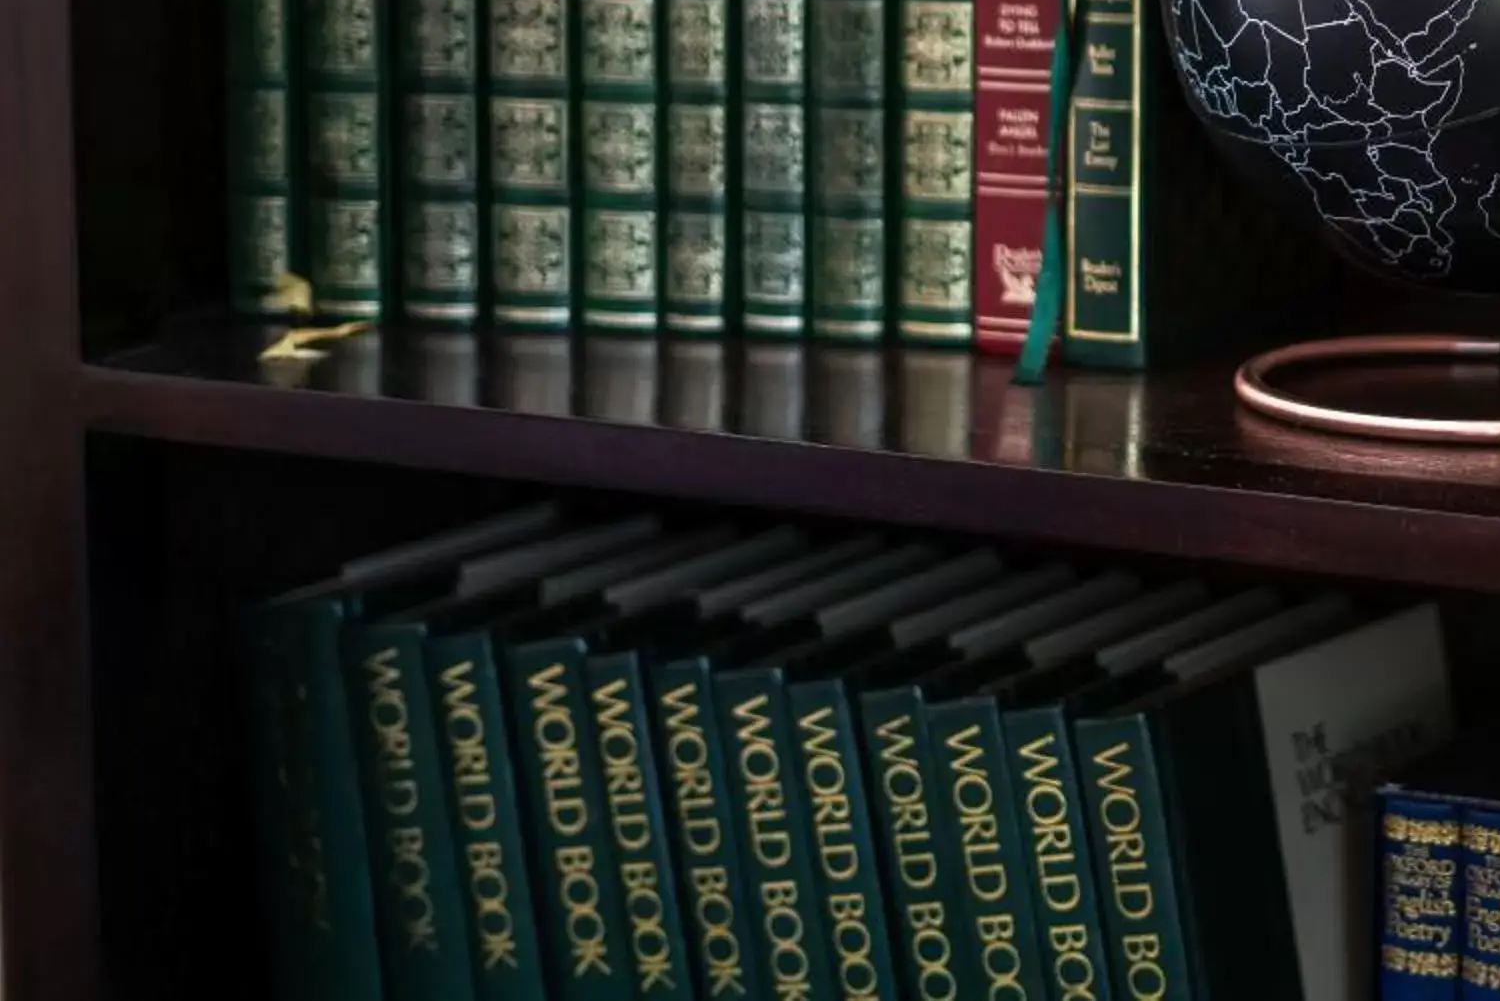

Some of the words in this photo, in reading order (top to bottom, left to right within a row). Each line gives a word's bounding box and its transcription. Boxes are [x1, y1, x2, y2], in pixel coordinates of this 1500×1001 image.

[364, 647, 419, 815] WORLD
[440, 660, 497, 830] WORLD
[526, 663, 588, 836] WORLD
[592, 679, 651, 850] WORLD
[732, 694, 792, 869] WORLD
[876, 715, 938, 889] WORLD
[945, 724, 1008, 901] WORLD
[466, 841, 518, 969] BOOK
[662, 682, 721, 856] WORLD
[692, 866, 747, 995] BOOK
[798, 706, 859, 881] WORLD
[829, 893, 880, 1001] BOO
[1018, 733, 1081, 913] WORLD
[1093, 742, 1154, 920] WORLD
[555, 845, 612, 978] BOOK
[621, 861, 676, 992] BOOK
